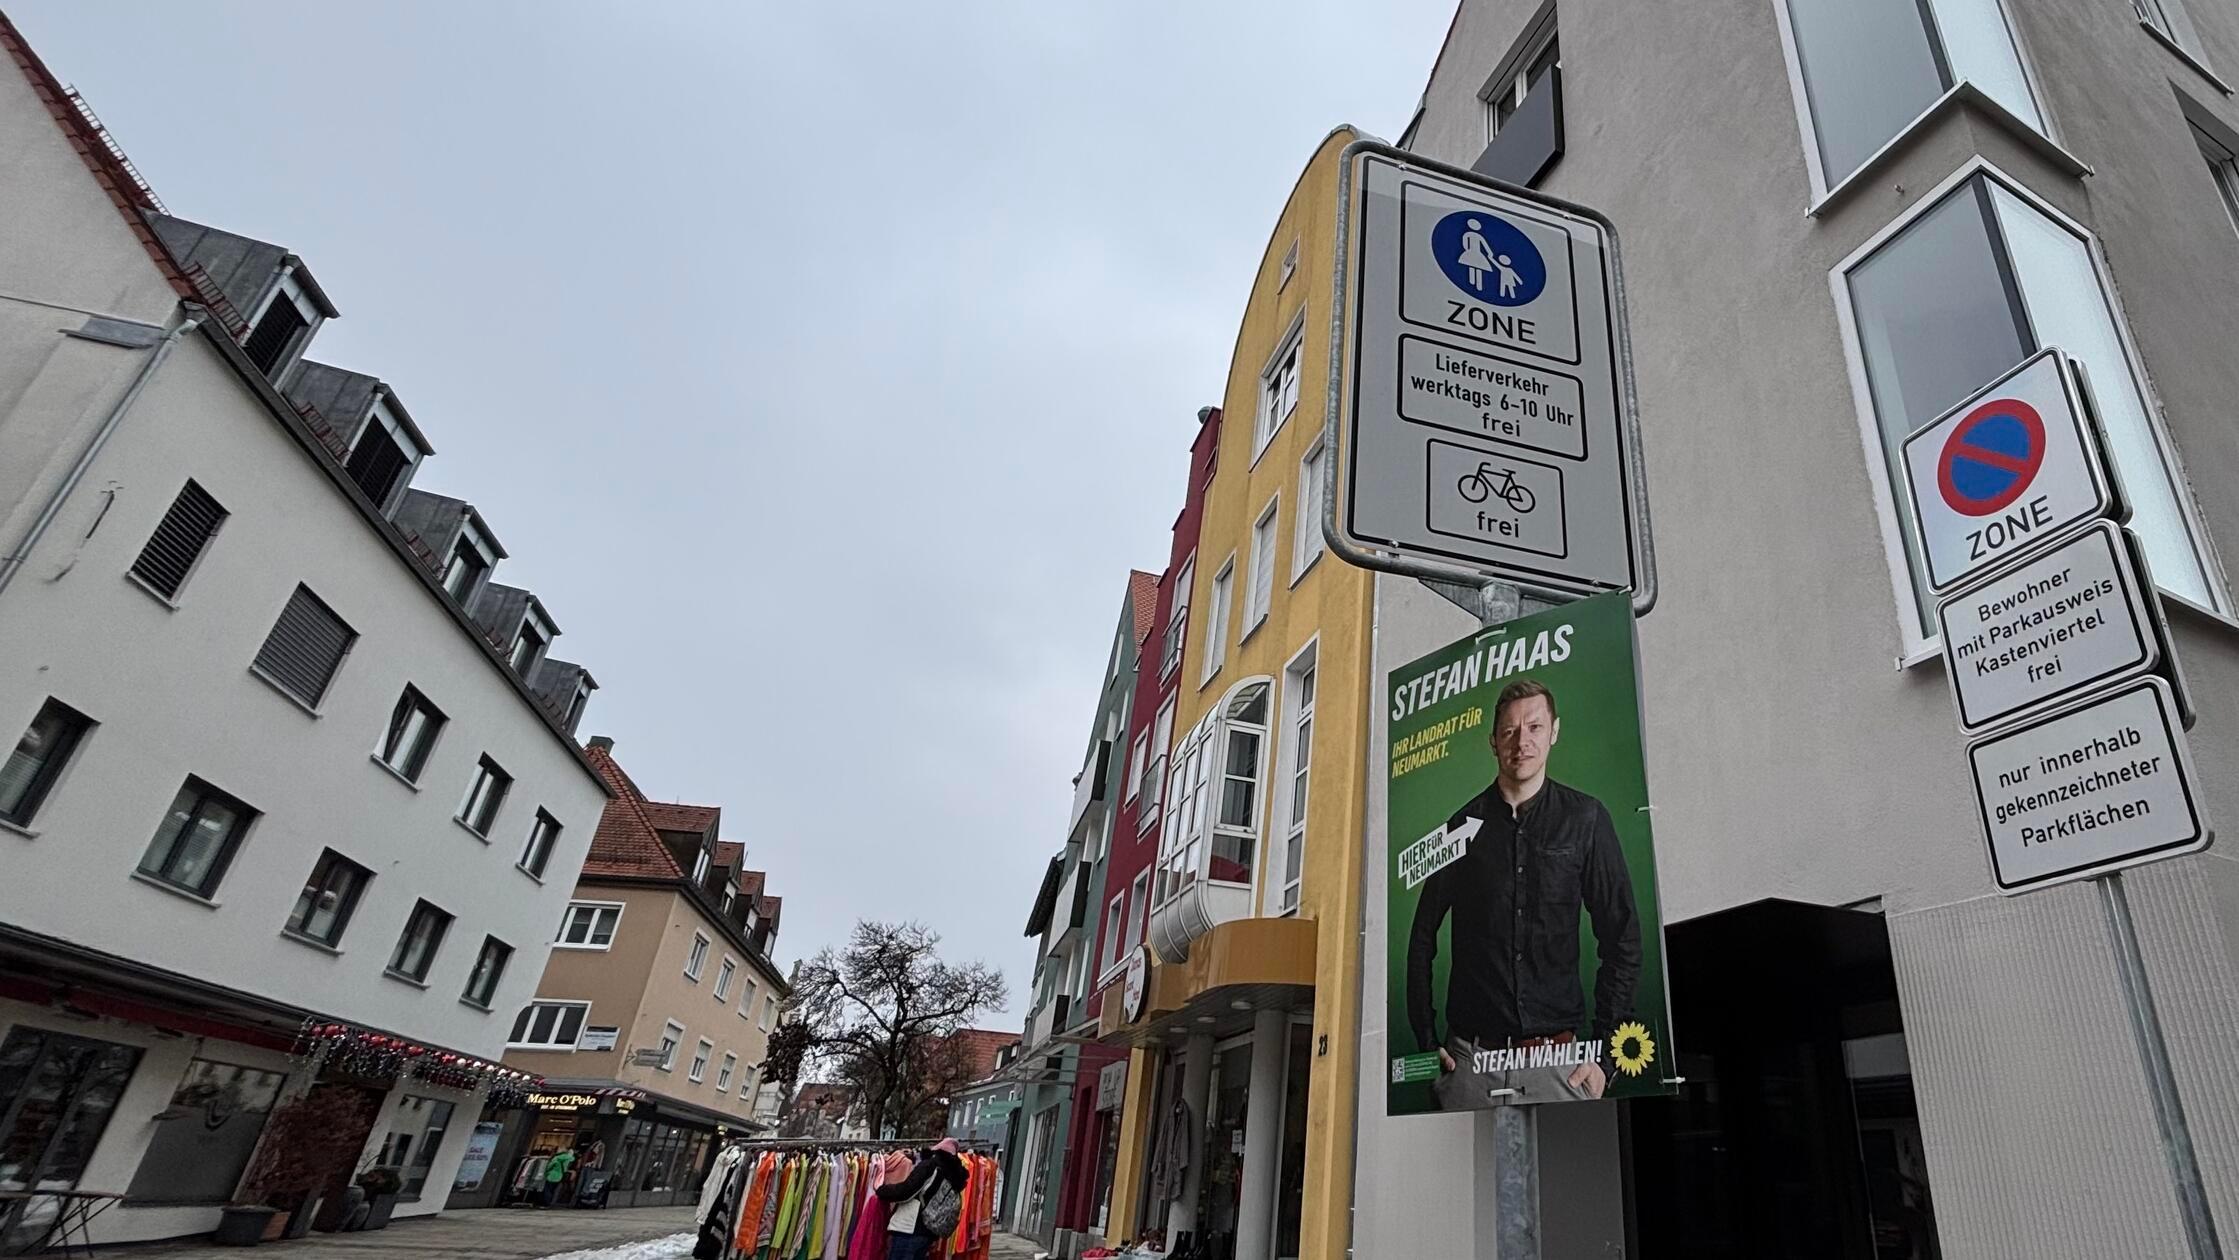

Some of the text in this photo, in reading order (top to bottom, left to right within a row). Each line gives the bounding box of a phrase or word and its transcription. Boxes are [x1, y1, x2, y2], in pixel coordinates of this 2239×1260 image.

[1447, 300, 1536, 345] ZONE
[1435, 353, 1549, 396] Lieferverkehr
[1411, 375, 1574, 426] werktags 6-10 Uhr
[1482, 412, 1521, 437] frei
[1476, 510, 1519, 538] frei
[1965, 495, 2053, 561] ZONE
[1957, 578, 2113, 659] mit Parkausweis
[1978, 568, 2071, 622] Bewohner
[1976, 608, 2105, 677] Kastenviertel
[1392, 624, 1574, 721] STEFAN HAAS
[2027, 654, 2062, 683] frei
[1392, 706, 1483, 759] IHR LANDRAT FÜR
[1392, 740, 1449, 779] NEUMARKT.
[1999, 727, 2141, 788] nur innerhalb
[1996, 756, 2160, 824] gekennzeichneter
[2021, 799, 2150, 847] Parkflächen
[1402, 831, 1443, 873] HIER FÜR
[1409, 838, 1460, 885] NEUMARKT
[1318, 1034, 1328, 1057] 23
[1473, 1047, 1526, 1074] STEFAN
[1529, 1039, 1603, 1068] WÄHLEN!
[526, 1093, 597, 1106] Marc O'Polo
